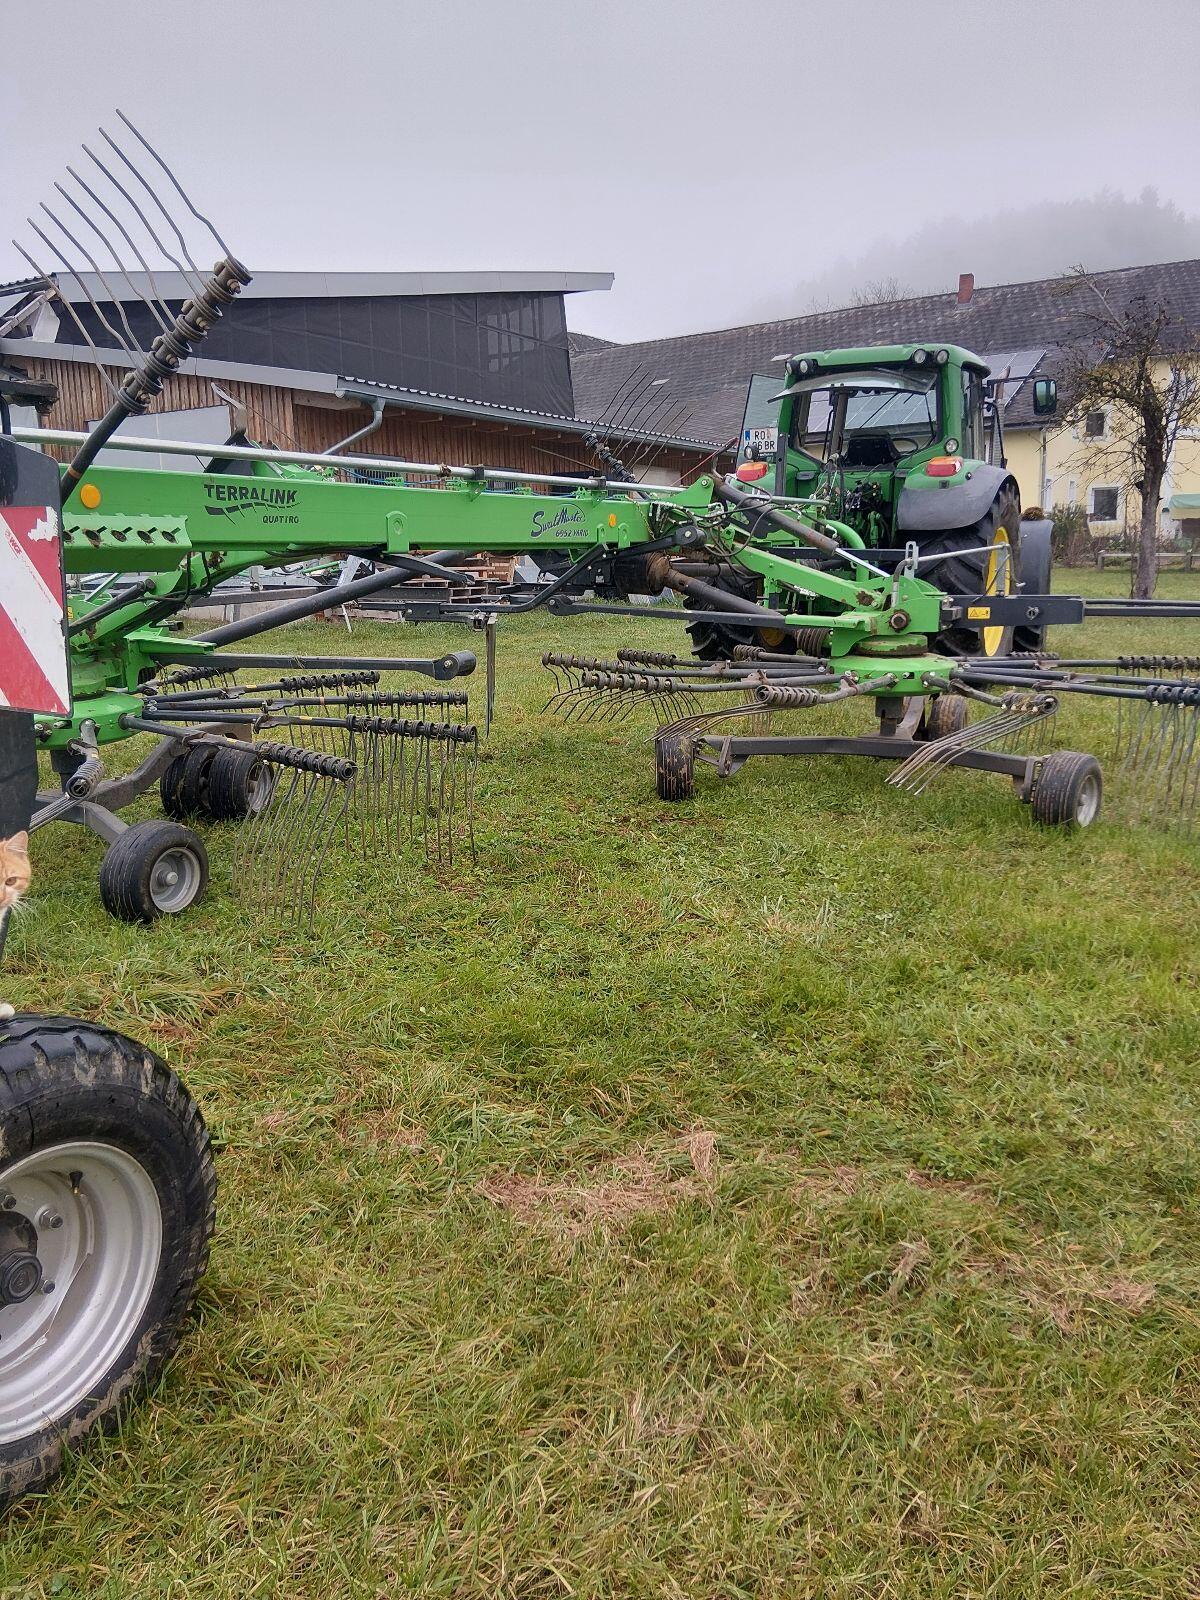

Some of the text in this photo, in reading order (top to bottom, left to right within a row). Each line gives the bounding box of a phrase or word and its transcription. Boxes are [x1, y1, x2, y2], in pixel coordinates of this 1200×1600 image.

[754, 430, 766, 441] RO
[203, 484, 297, 504] TERRALINK
[262, 515, 300, 524] QUATTRO
